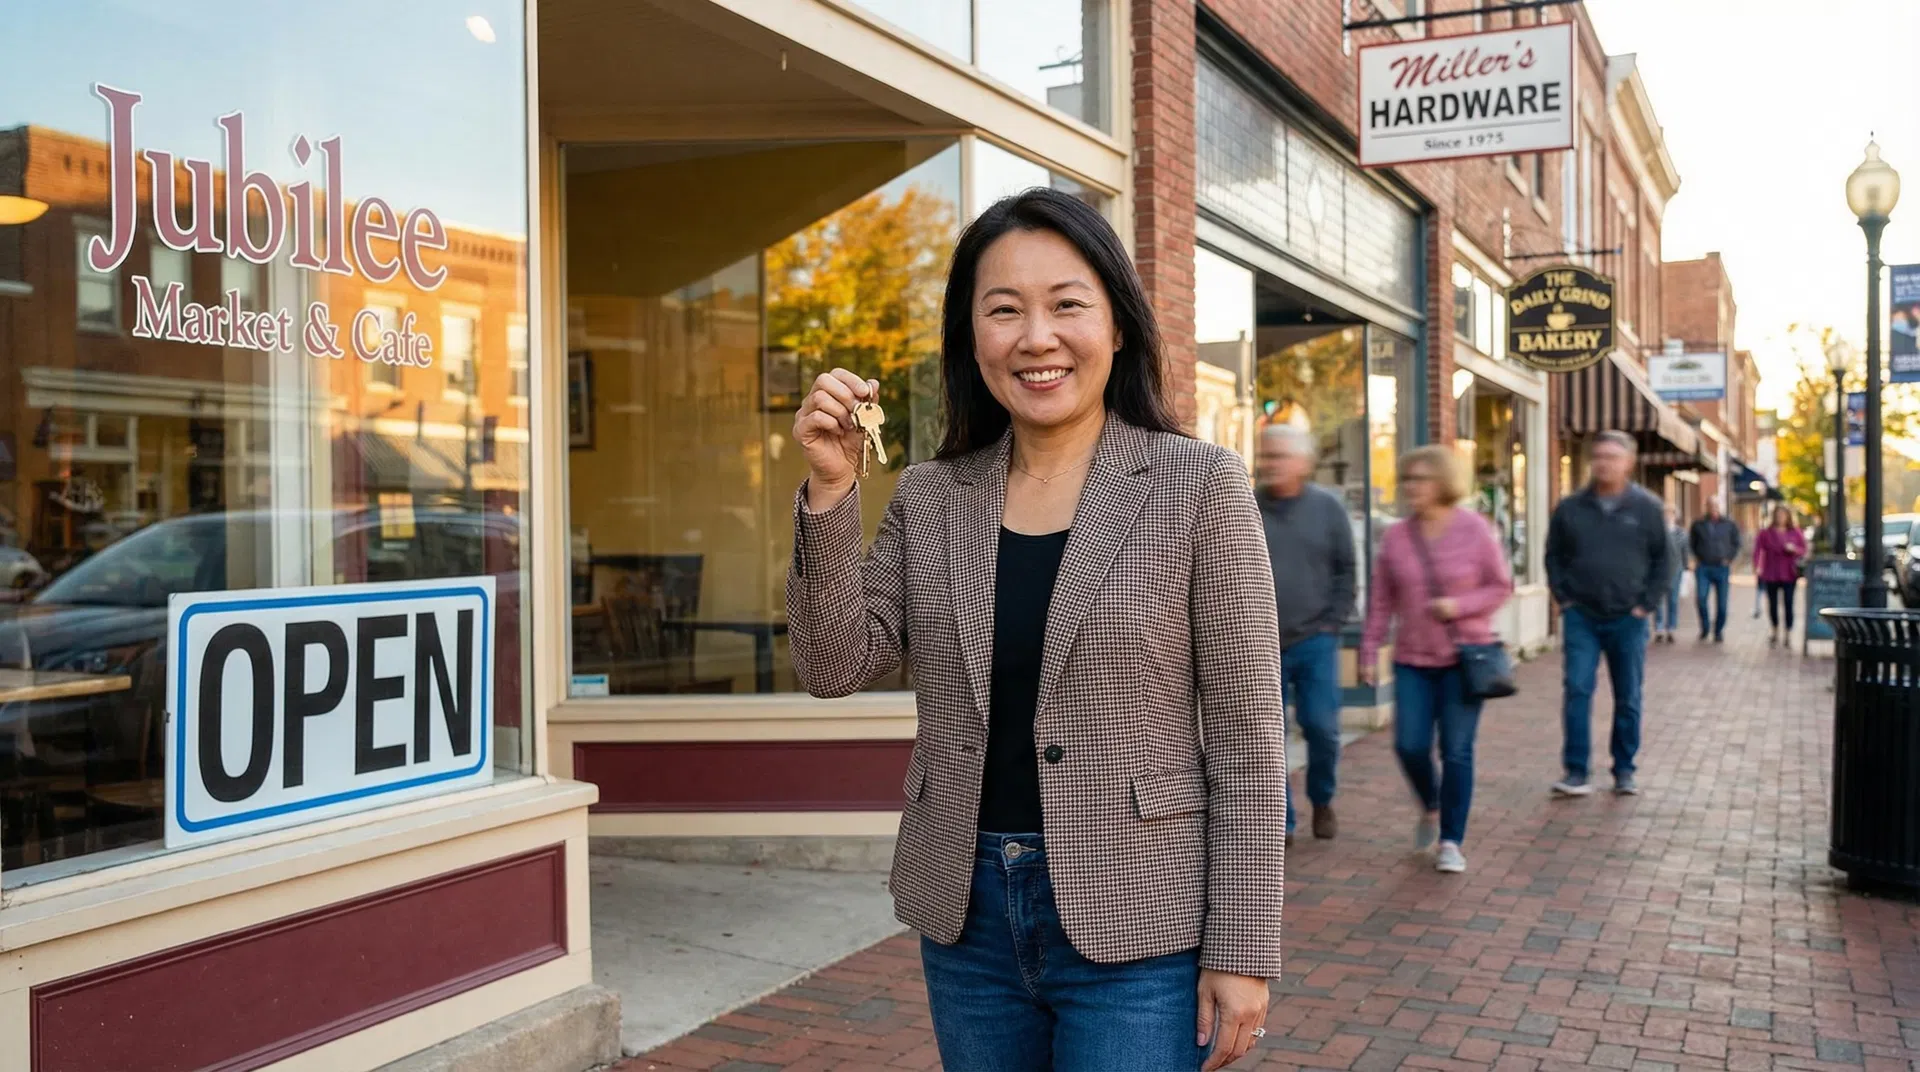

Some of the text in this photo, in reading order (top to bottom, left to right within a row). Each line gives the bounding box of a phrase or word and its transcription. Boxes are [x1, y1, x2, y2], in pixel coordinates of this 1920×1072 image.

[1389, 40, 1536, 90] Miller's
[1370, 82, 1561, 128] HARDWARE
[1424, 131, 1504, 151] Since 1975
[88, 82, 449, 291] Jubilee
[1511, 287, 1611, 315] DAILY GRIND
[1545, 272, 1576, 287] THE
[131, 276, 432, 368] Market & Cafe
[1519, 331, 1601, 352] BAKERY
[198, 609, 474, 803] OPEN
